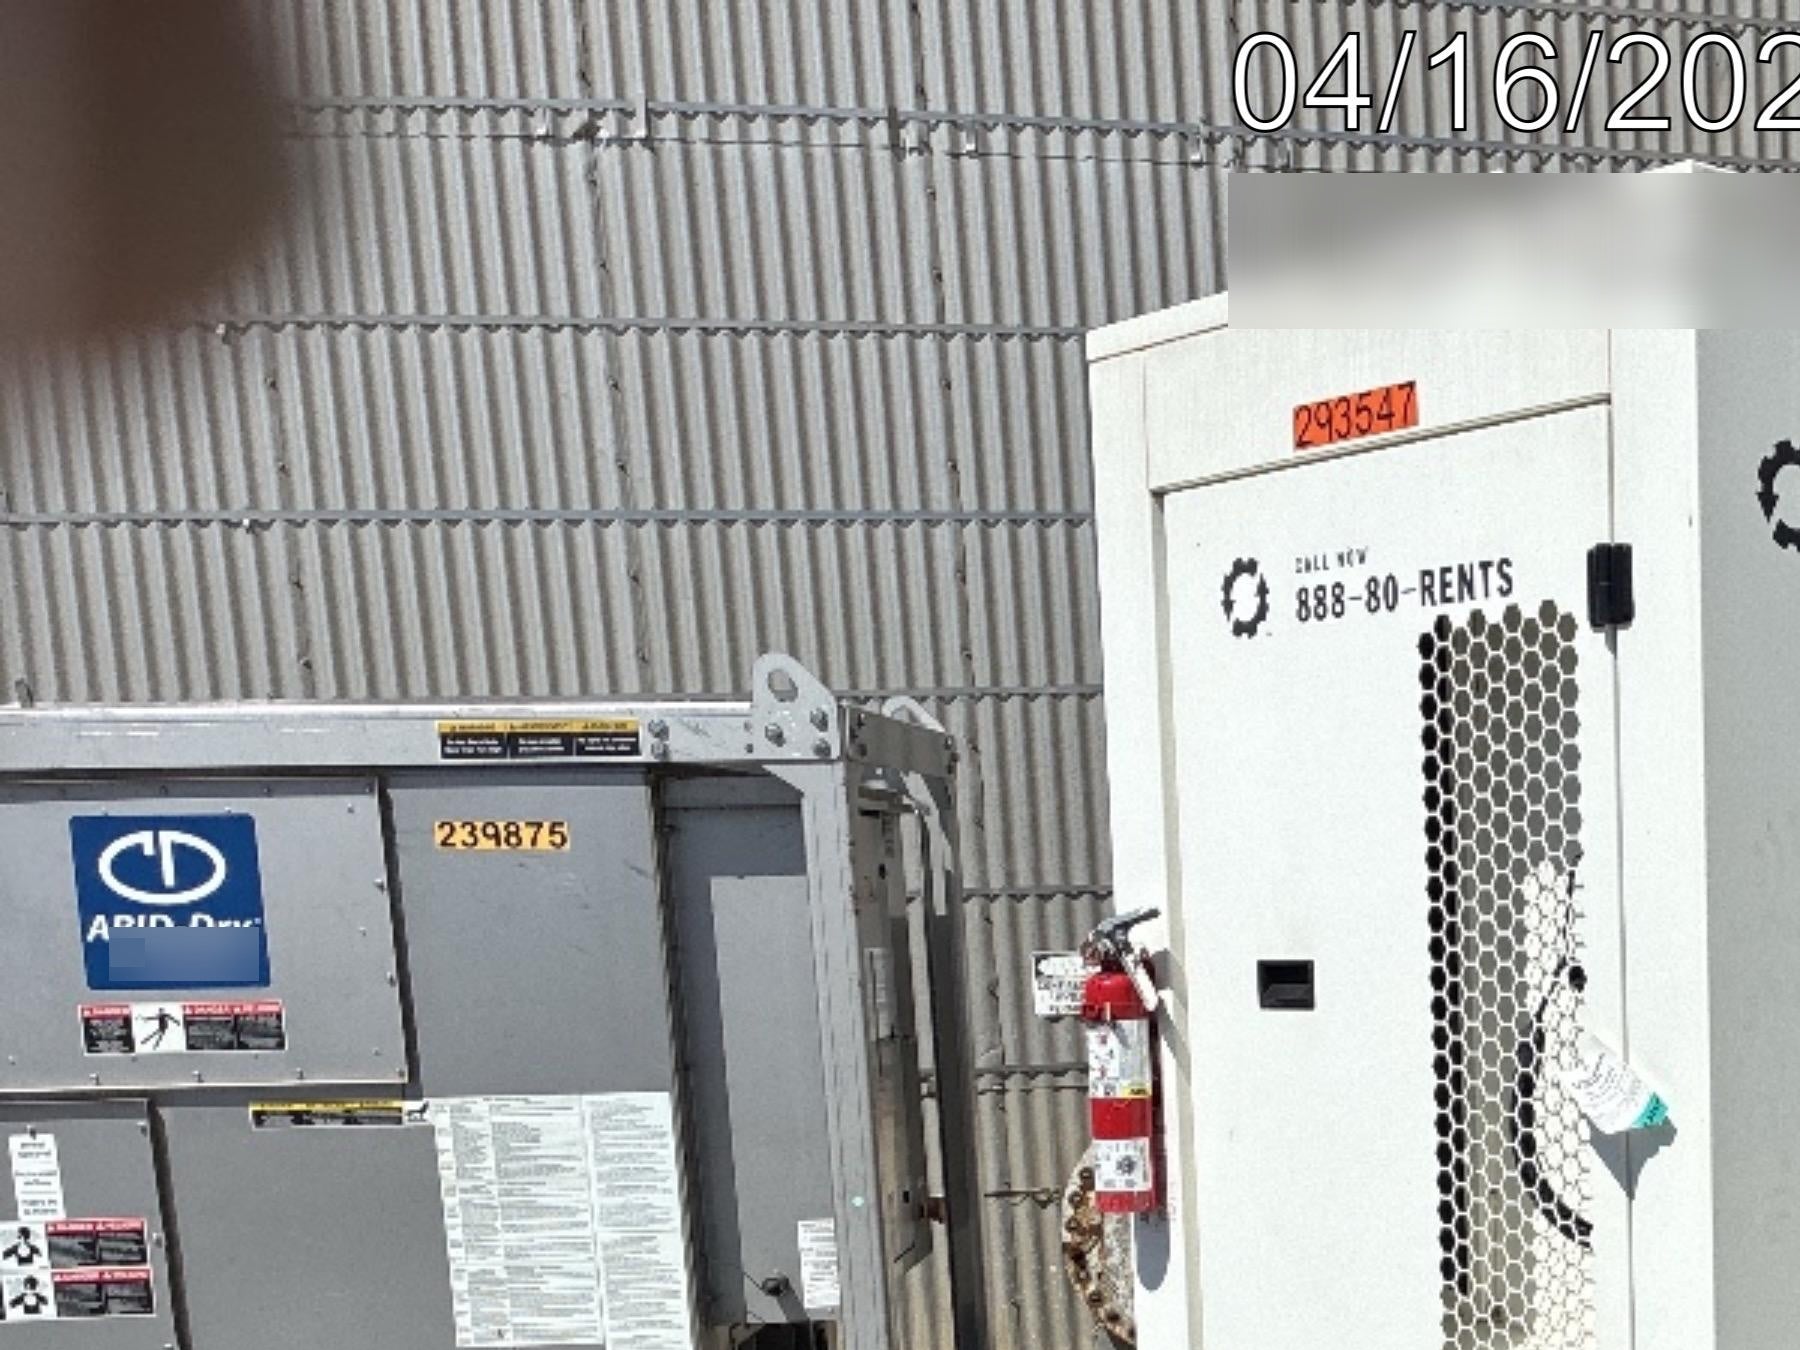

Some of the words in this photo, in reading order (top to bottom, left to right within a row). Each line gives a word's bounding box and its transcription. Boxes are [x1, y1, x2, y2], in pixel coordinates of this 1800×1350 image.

[1295, 380, 1416, 449] 293547
[1295, 556, 1514, 623] 888-80-RENTS
[437, 820, 568, 847] 239875
